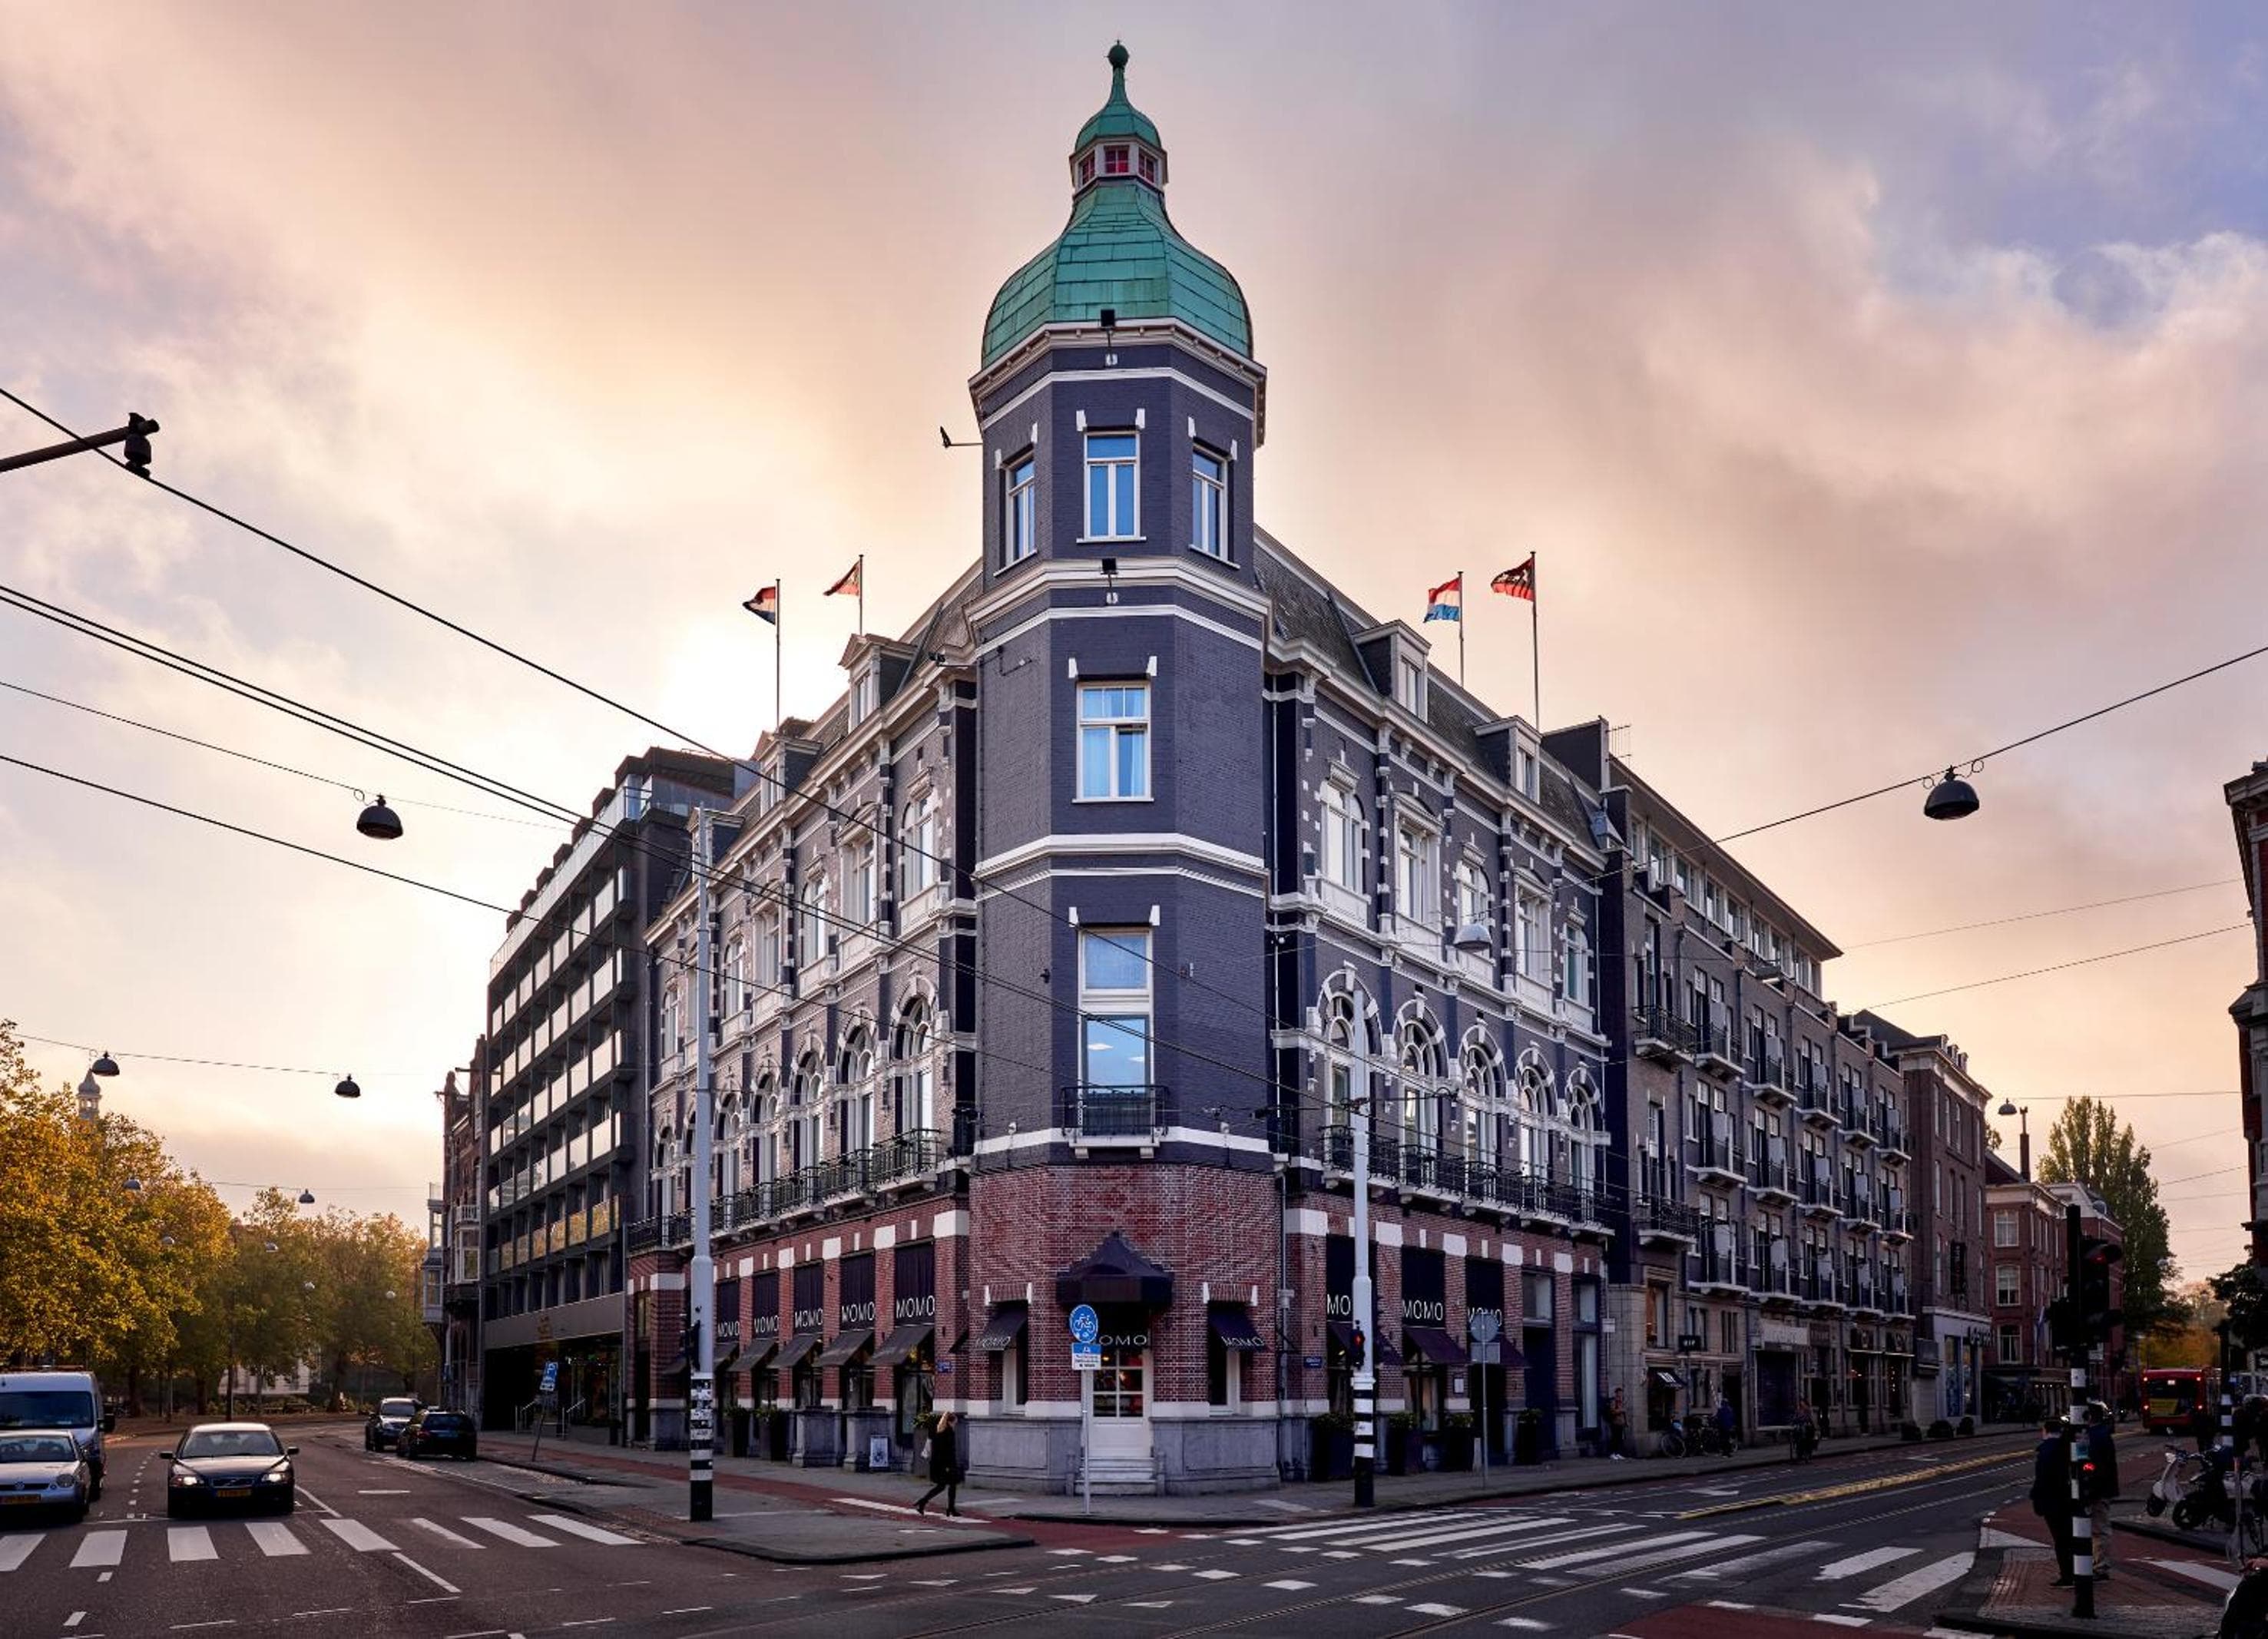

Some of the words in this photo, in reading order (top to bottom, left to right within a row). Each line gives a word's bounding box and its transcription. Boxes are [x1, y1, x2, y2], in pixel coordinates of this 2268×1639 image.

[842, 1301, 875, 1323] MOMO
[896, 1295, 935, 1319] MOMO
[1402, 1300, 1444, 1321] MOMO
[1468, 1306, 1502, 1326] MO
[795, 1308, 823, 1328] MOMO
[1094, 1334, 1147, 1346] OMO
[1220, 1336, 1265, 1347] MOMO
